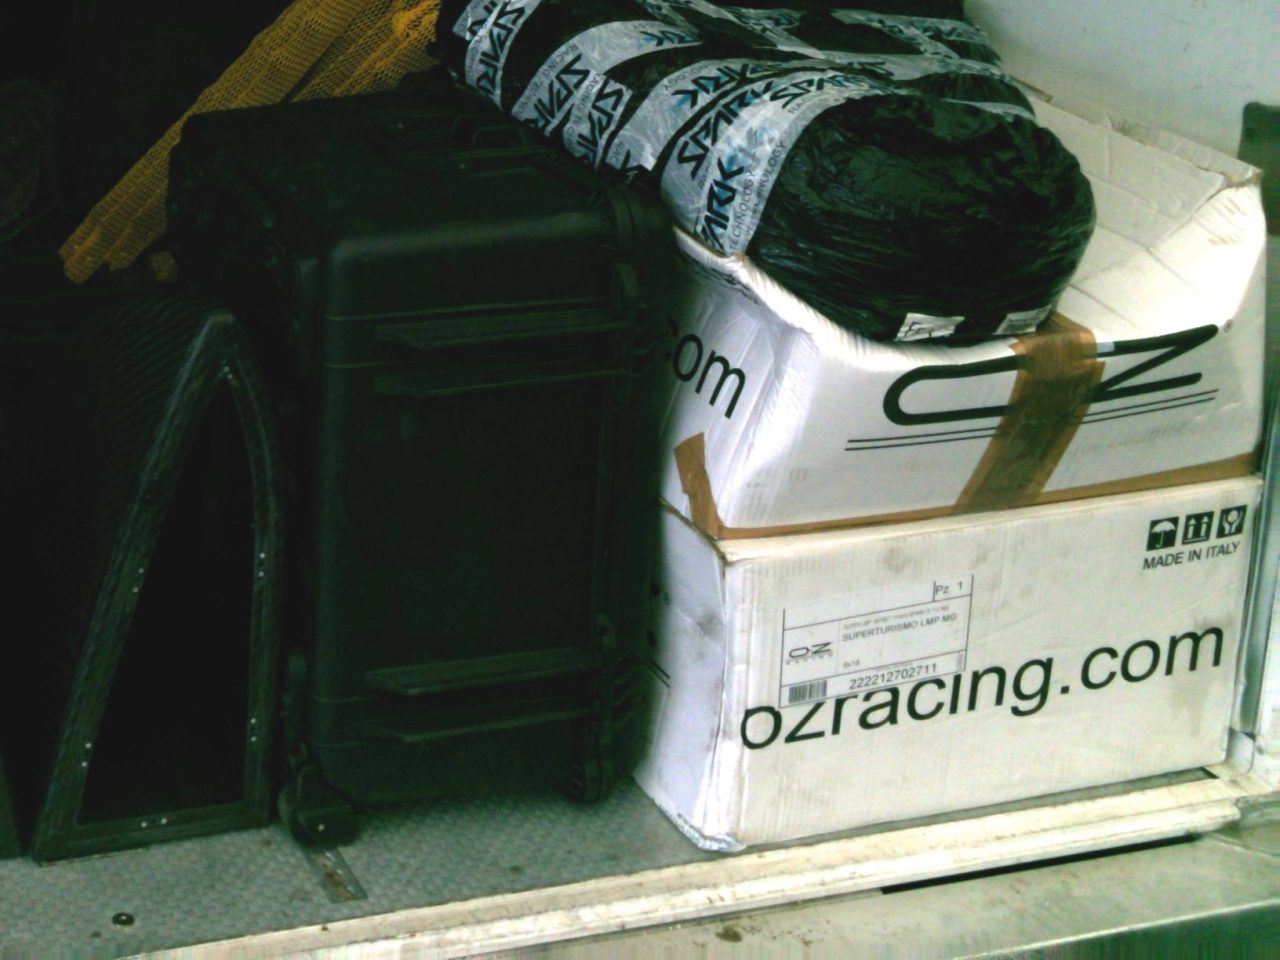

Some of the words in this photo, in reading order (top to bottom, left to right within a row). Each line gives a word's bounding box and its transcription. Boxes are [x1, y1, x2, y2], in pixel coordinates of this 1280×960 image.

[1142, 551, 1184, 571] MADE
[1187, 548, 1203, 562] IN
[1205, 540, 1241, 559] ITALY
[841, 619, 919, 643] SUPERTURISMO
[739, 626, 1225, 751] ozracing.com
